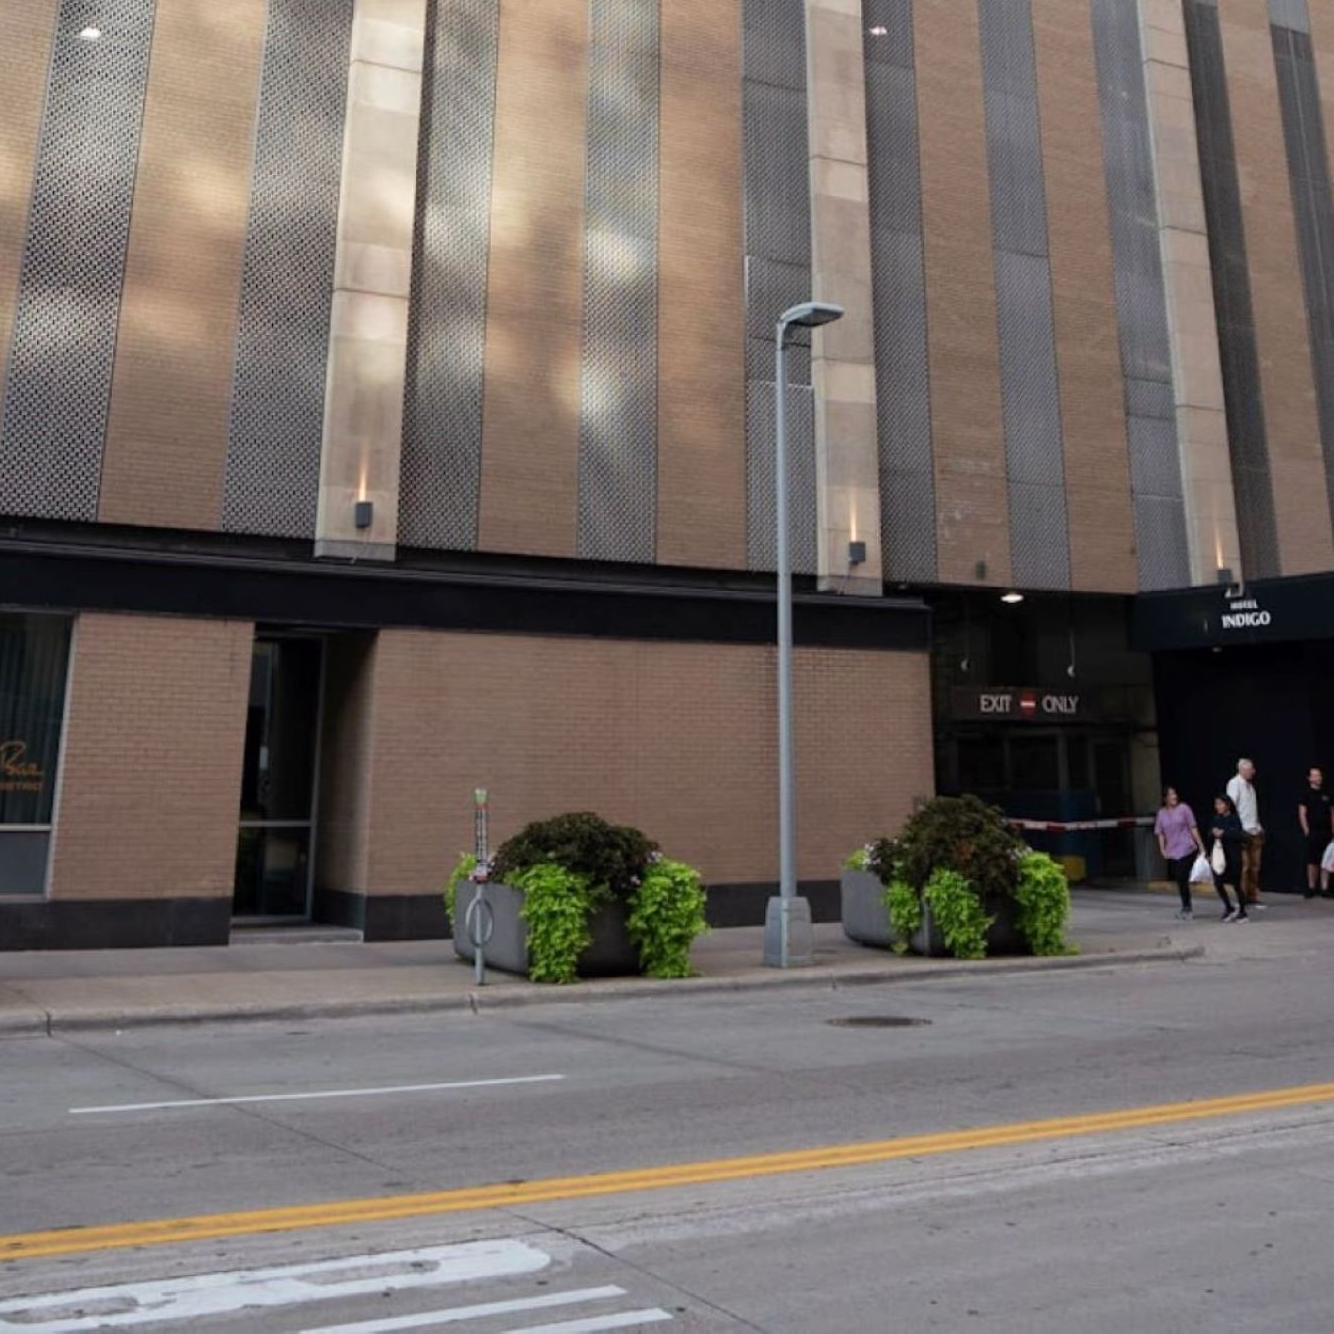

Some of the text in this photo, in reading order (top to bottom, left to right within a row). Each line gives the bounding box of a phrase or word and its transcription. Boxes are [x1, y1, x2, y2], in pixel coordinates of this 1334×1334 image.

[1221, 611, 1271, 629] INDIGO
[979, 694, 1079, 713] EXIT ONLY
